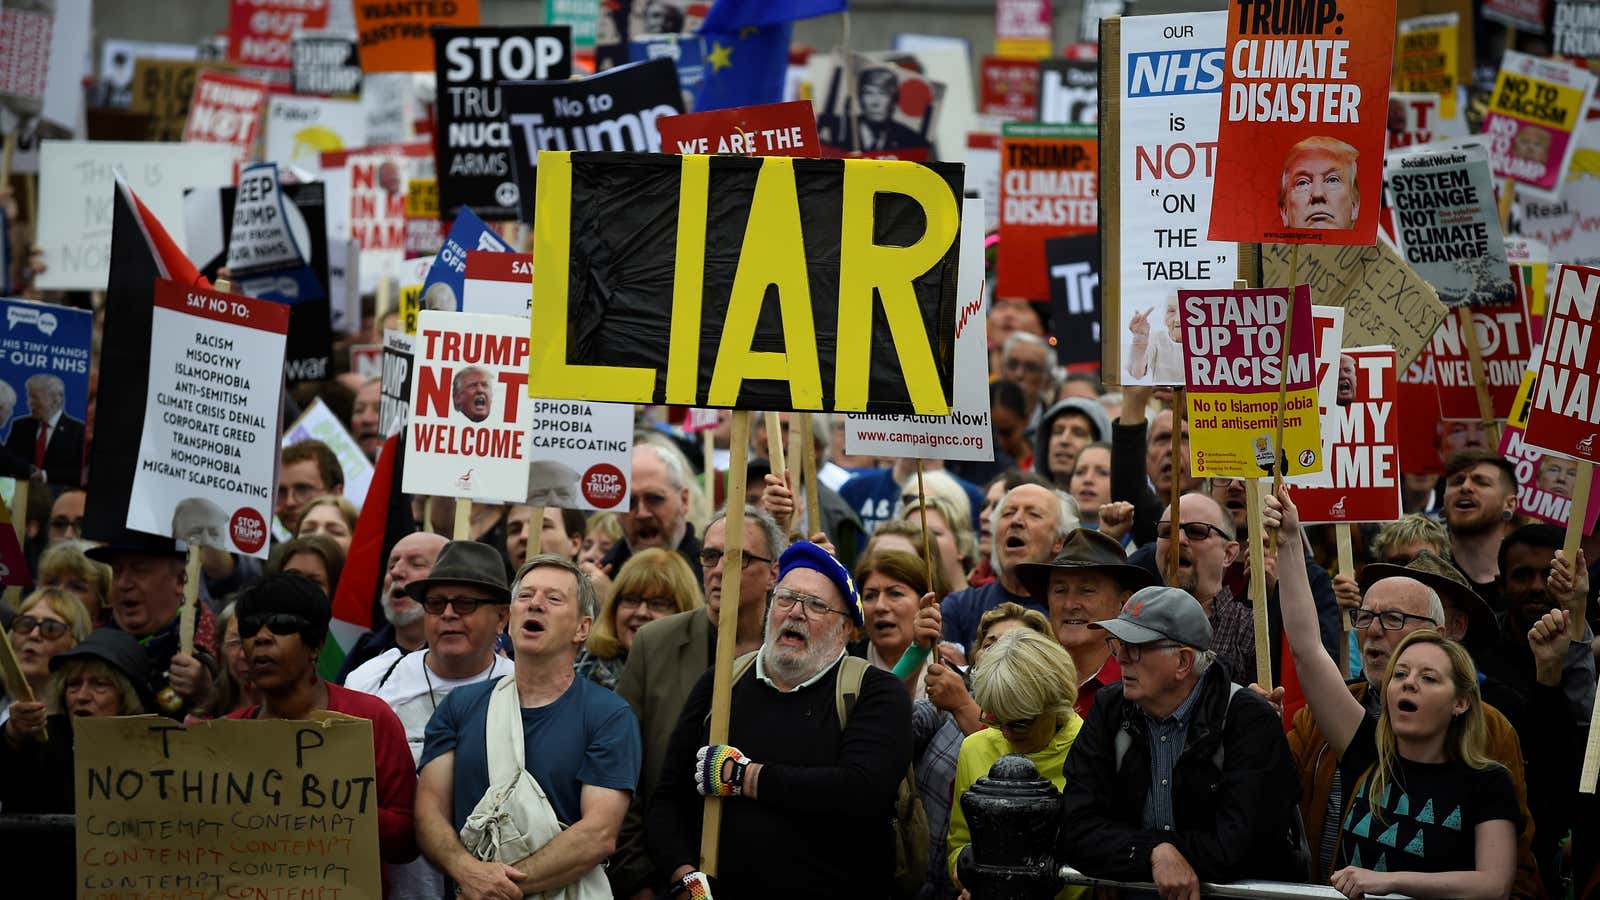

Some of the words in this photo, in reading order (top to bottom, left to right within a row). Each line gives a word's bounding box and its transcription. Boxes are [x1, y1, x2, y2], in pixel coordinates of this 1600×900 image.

[1238, 0, 1345, 36] TRUMP:
[1163, 25, 1194, 39] OUR
[445, 36, 564, 81] STOP
[1231, 39, 1350, 79] CLIMATE
[1129, 51, 1226, 94] NHS
[448, 87, 501, 117] TRU
[1228, 82, 1362, 123] DISASTER
[1503, 76, 1529, 97] NO
[1534, 81, 1560, 106] TO
[553, 97, 584, 117] No
[587, 94, 613, 113] to
[1497, 93, 1568, 126] RACISM
[449, 122, 512, 147] NUCL
[1169, 112, 1186, 131] is
[508, 105, 682, 167] Trump
[677, 138, 709, 154] WE
[717, 132, 757, 154] ARE
[761, 126, 804, 151] THE
[449, 152, 508, 176] ARMS
[1007, 144, 1091, 168] TRUMP:
[1135, 142, 1219, 181] NOT
[239, 177, 273, 203] EEP
[1003, 170, 1097, 197] CLIMATE
[1392, 169, 1471, 192] SYSTEM
[1396, 187, 1480, 210] CHANGE
[1525, 200, 1568, 219] Real
[1400, 210, 1437, 228] NOT
[1153, 228, 1197, 248] THE
[1403, 222, 1489, 246] CLIMATE
[1407, 242, 1489, 264] CHANGE
[528, 149, 961, 416] LIAR
[1297, 254, 1346, 292] MUST
[1051, 262, 1098, 315] Tr
[186, 293, 206, 308] SAY
[209, 298, 227, 314] NO
[230, 302, 250, 318] TO:
[1185, 295, 1288, 326] STAND
[195, 333, 234, 351] RACISM
[423, 329, 531, 367] TRUMP
[1187, 326, 1232, 356] UP
[1236, 325, 1282, 356] TO
[1432, 312, 1522, 358] NOT
[1546, 317, 1594, 371] IN
[3, 339, 21, 350] HIS
[24, 341, 49, 353] TINY
[51, 345, 88, 360] HANDS
[10, 351, 48, 368] OUR
[52, 356, 87, 374] NHS
[186, 347, 241, 370] MISOGYNY
[175, 362, 250, 390] ISLAMOPHOBIA
[1190, 353, 1311, 387] RACISM
[175, 380, 248, 407] ANTI-SEMITISM
[1194, 399, 1211, 412] No
[1214, 400, 1227, 412] to
[1231, 396, 1314, 415] Islamopobia
[157, 392, 193, 412] CLIMATE
[195, 402, 226, 420] CRISIS
[229, 410, 266, 429] DENIAL
[534, 402, 593, 416] SPHOBIA
[951, 411, 988, 426] Now!
[163, 411, 220, 436] CORPORATE
[222, 426, 256, 443] GREED
[533, 419, 593, 433] OPHOBIA
[1195, 416, 1218, 429] and
[1221, 416, 1302, 430] antisemitsm
[1336, 402, 1393, 444] MY
[173, 431, 242, 458] TRANSPHOBIA
[414, 422, 525, 460] WELCOME
[533, 436, 627, 452] CAPEGOATING
[857, 431, 984, 450] www.campaigncc.org
[170, 448, 241, 475] HOMOPHOBIA
[143, 459, 187, 480] MIGRANT
[188, 470, 268, 498] SCAPEGOATING
[587, 482, 622, 493] TRUMP
[591, 473, 618, 483] STOP
[233, 525, 263, 539] TRUMP
[237, 516, 261, 528] STOP
[295, 728, 325, 769] P
[88, 766, 283, 807] NOTHING
[301, 773, 375, 816] BUT
[86, 815, 225, 840] CONTEMPT
[231, 811, 357, 834] CONTEMPT
[229, 837, 353, 857] CONTEMPT
[84, 872, 225, 892] CONTEMPT
[228, 861, 352, 887] CONTEMPT
